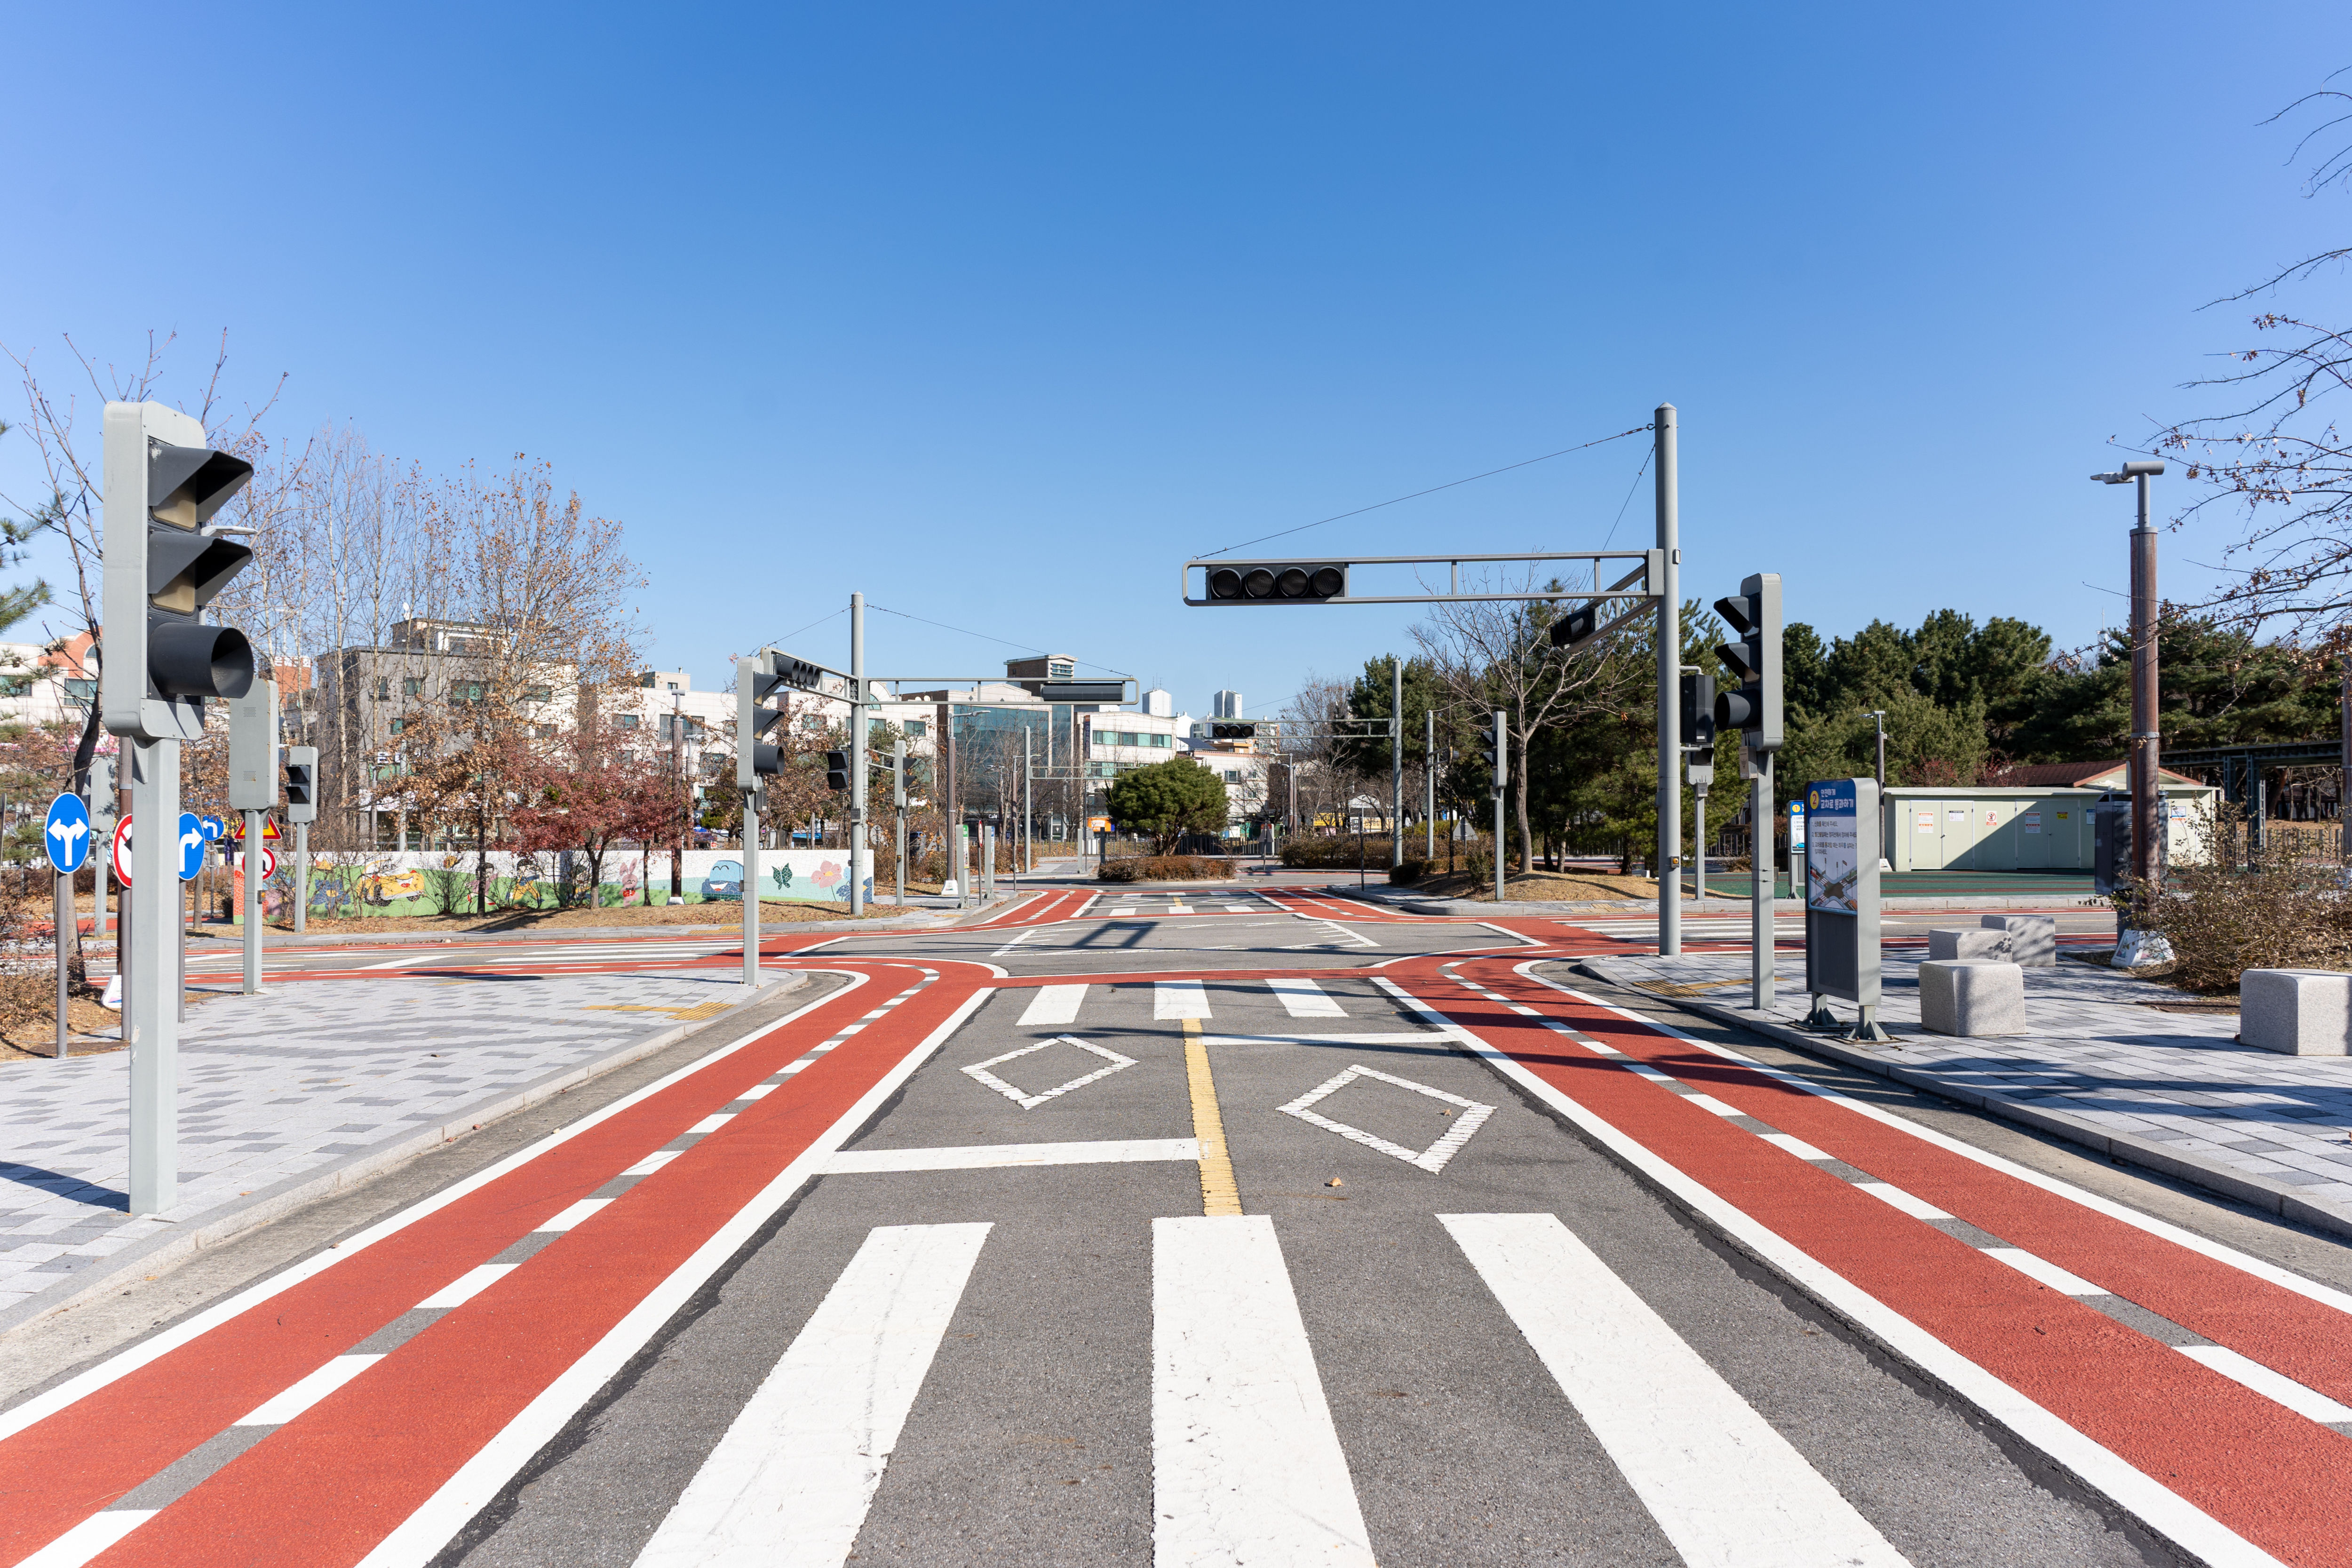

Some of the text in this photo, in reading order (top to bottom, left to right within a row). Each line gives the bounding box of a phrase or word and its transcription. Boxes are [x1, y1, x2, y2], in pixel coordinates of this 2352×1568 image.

[1820, 788, 1836, 797] 안전하게
[1812, 793, 1817, 805] 2
[1820, 798, 1853, 810] 교차로 통과하기
